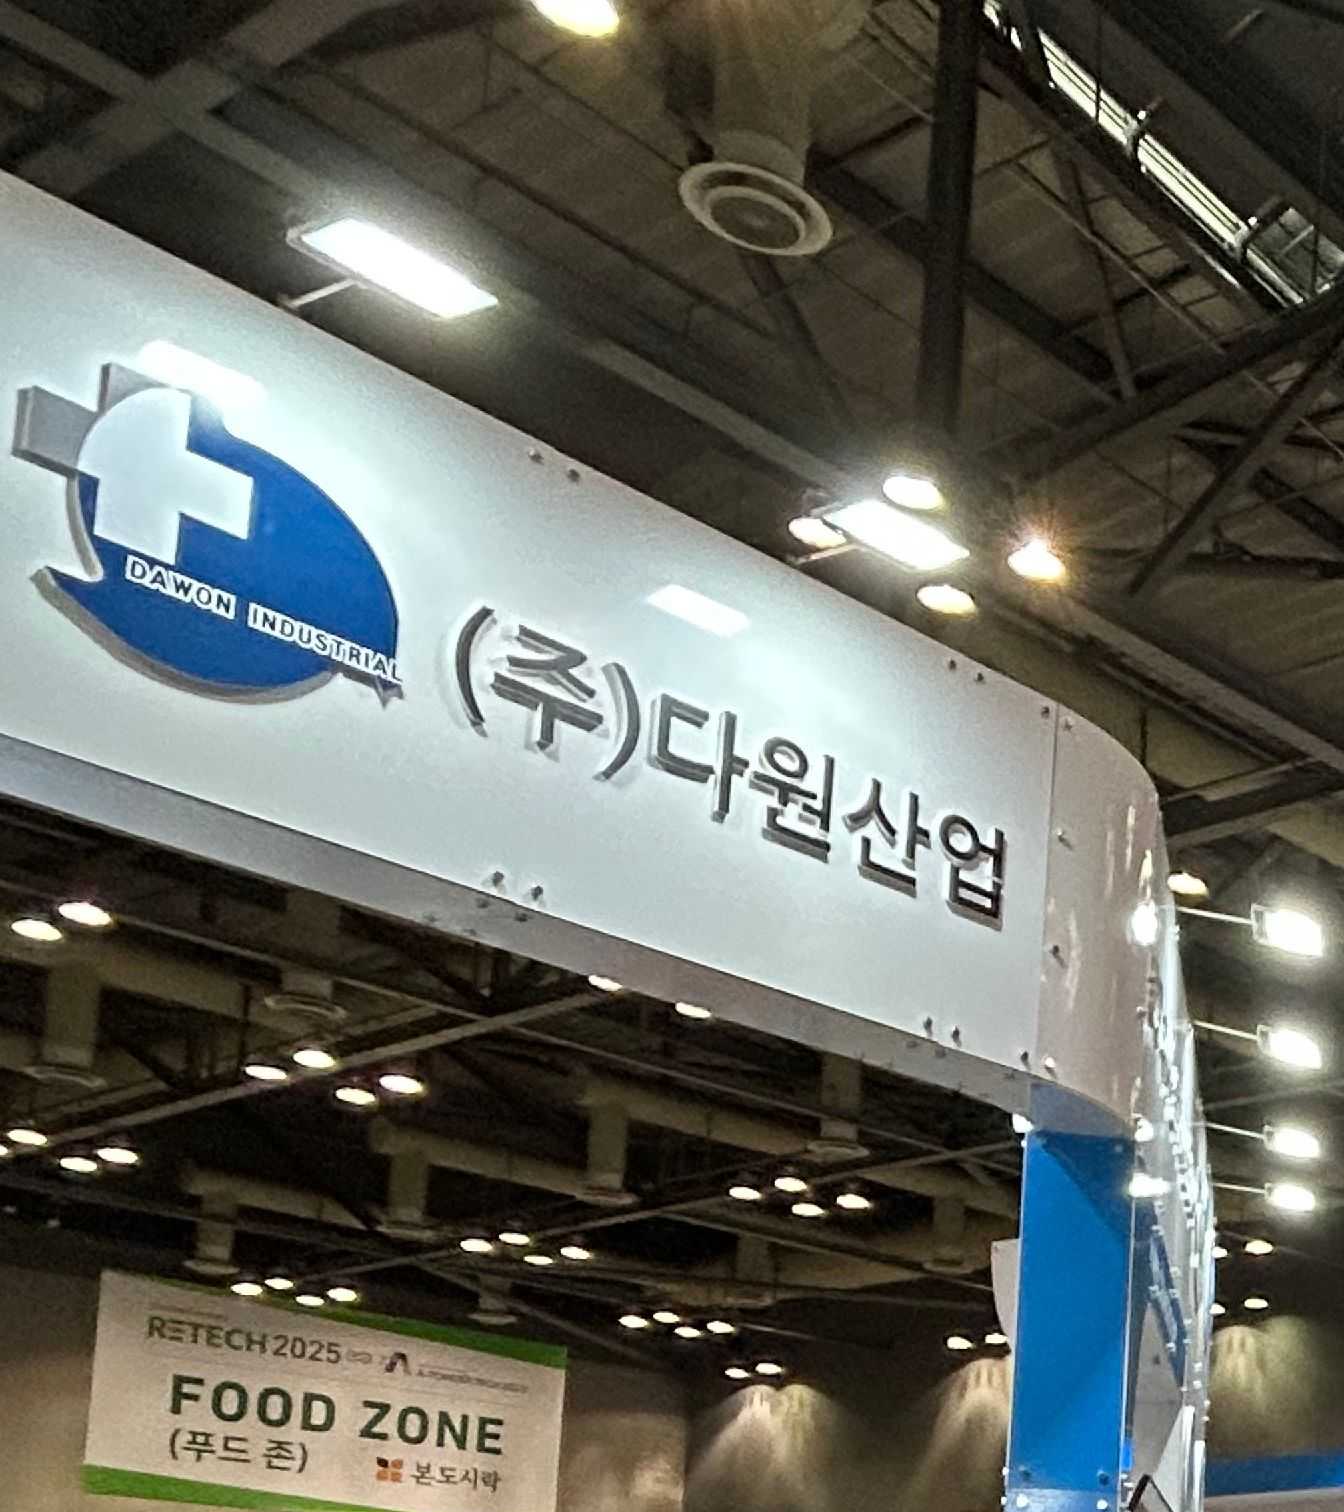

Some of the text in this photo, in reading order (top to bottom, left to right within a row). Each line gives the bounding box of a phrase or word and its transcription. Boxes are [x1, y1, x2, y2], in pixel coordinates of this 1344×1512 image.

[129, 559, 403, 682] DAWON INDUSTRIAL
[456, 606, 1005, 932] (주)다원산업
[146, 1316, 342, 1365] RETECH 2025
[169, 1373, 504, 1456] FOOD ZONE
[168, 1427, 309, 1474] (푸드 존)
[410, 1461, 501, 1493] 본도시락
